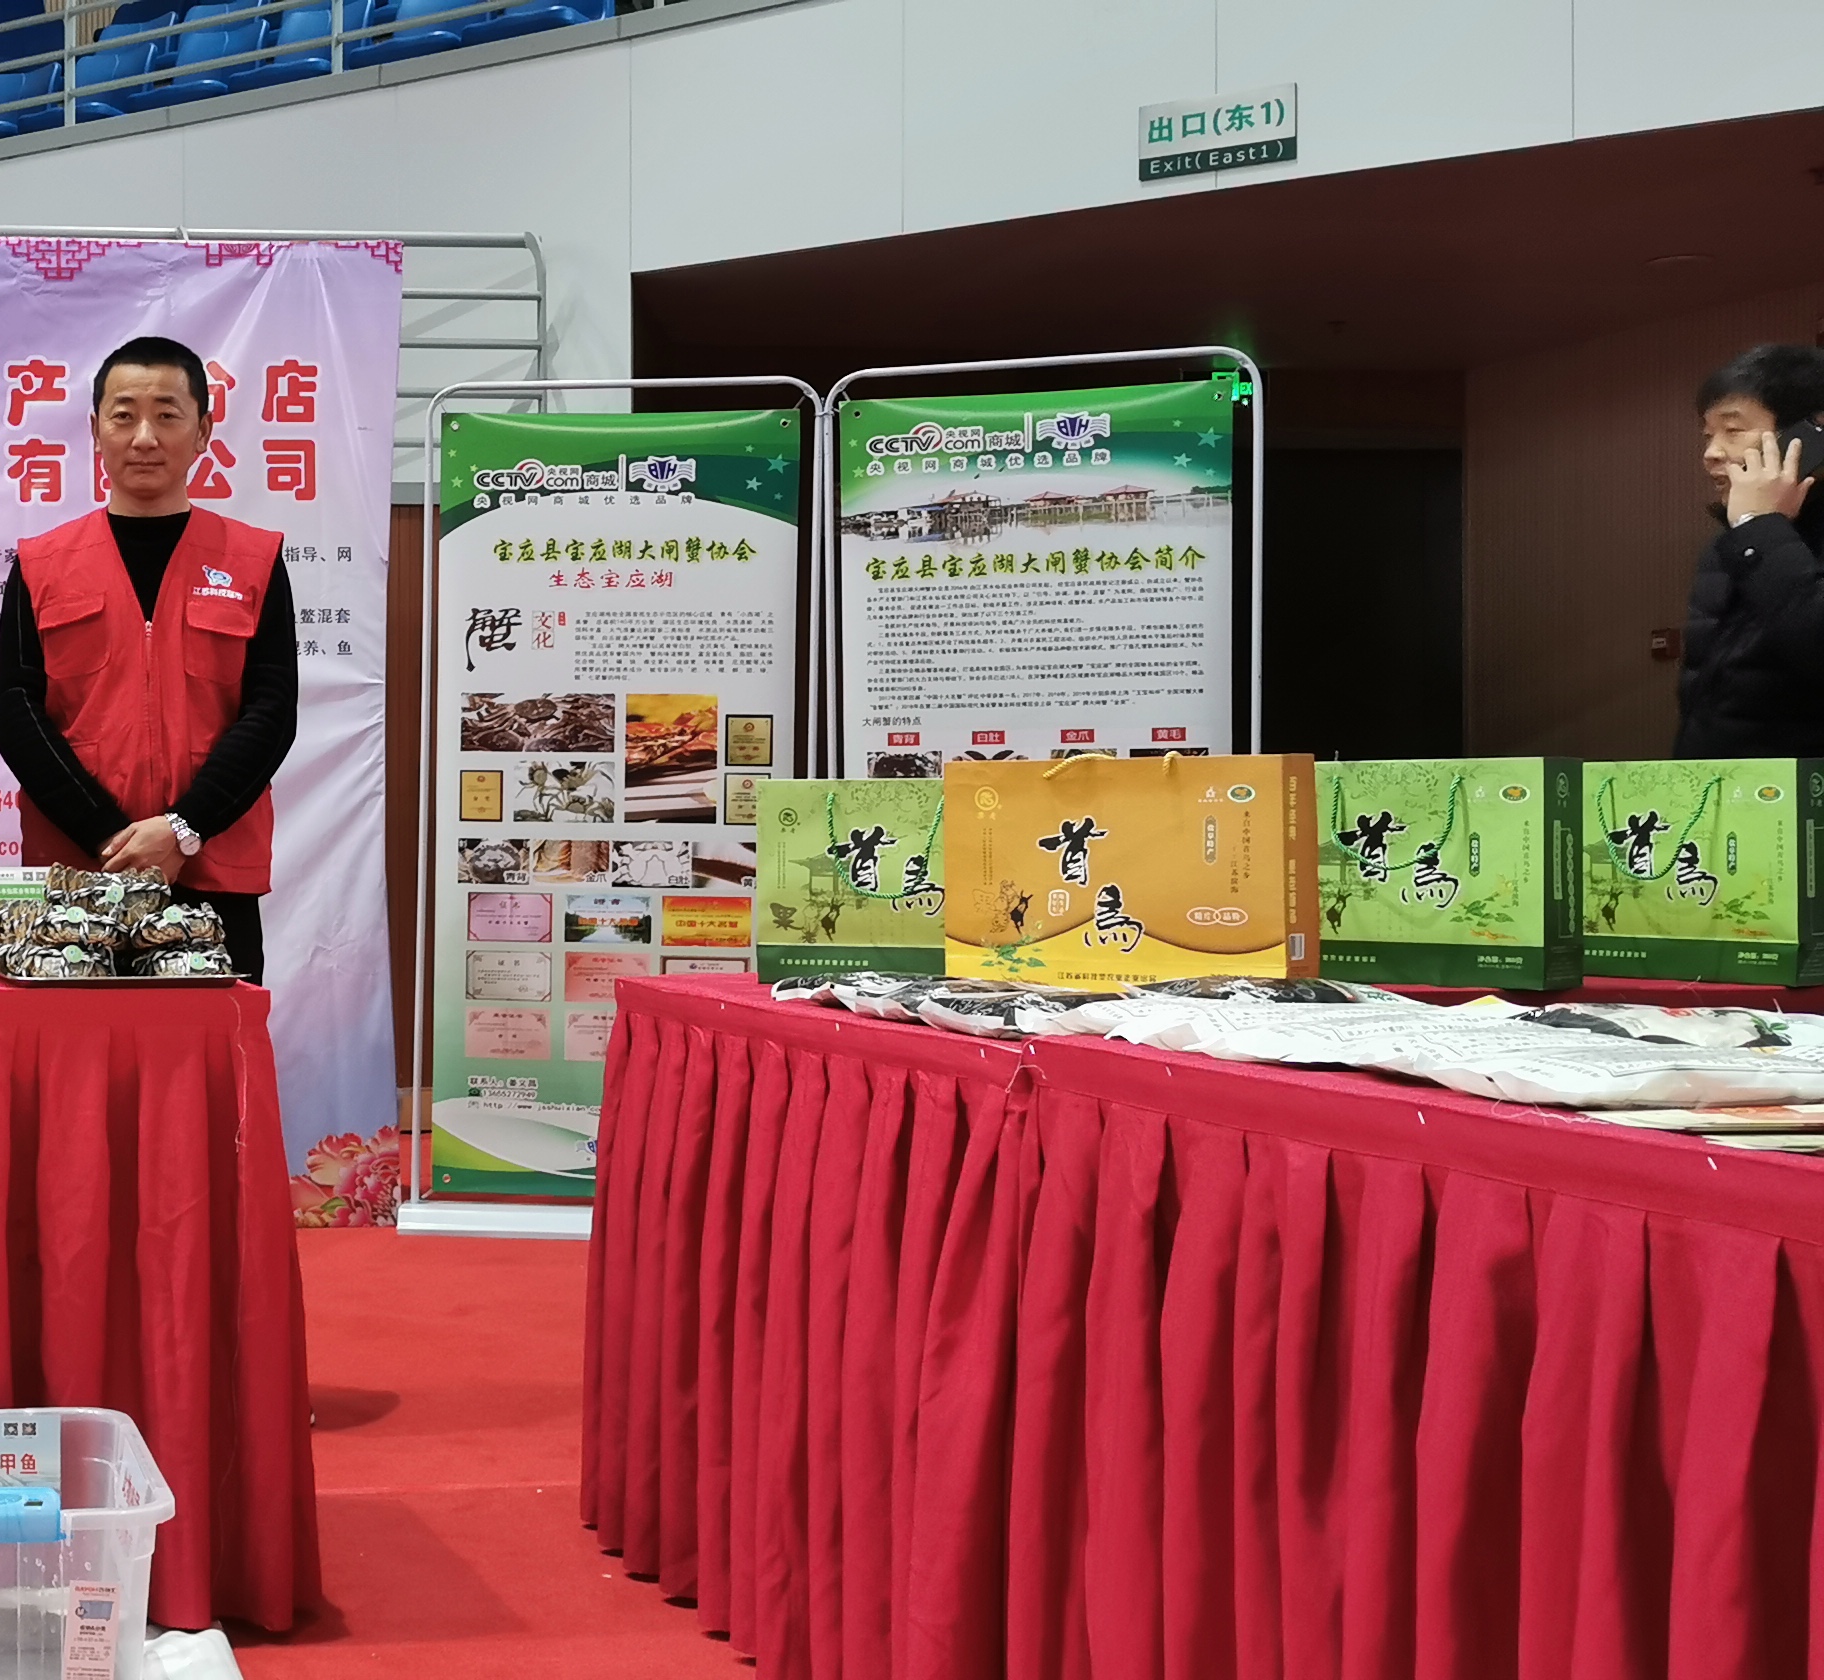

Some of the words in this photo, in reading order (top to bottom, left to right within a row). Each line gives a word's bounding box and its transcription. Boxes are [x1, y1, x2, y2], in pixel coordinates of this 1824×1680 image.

[1147, 98, 1286, 145] 出口(东1)
[868, 451, 1109, 474] 央视网商城优选品牌
[475, 495, 694, 506] 央视网商城优选品牌
[493, 538, 757, 564] 宝应县宝应湖大闸蟹协会
[864, 545, 1206, 582] 宝应县宝应湖大闸蟹协会简介
[548, 569, 674, 590] 生态宝应湖
[295, 608, 352, 625] 鳖混套
[532, 611, 555, 649] 文化
[861, 716, 922, 728] 大闸蟹的特点
